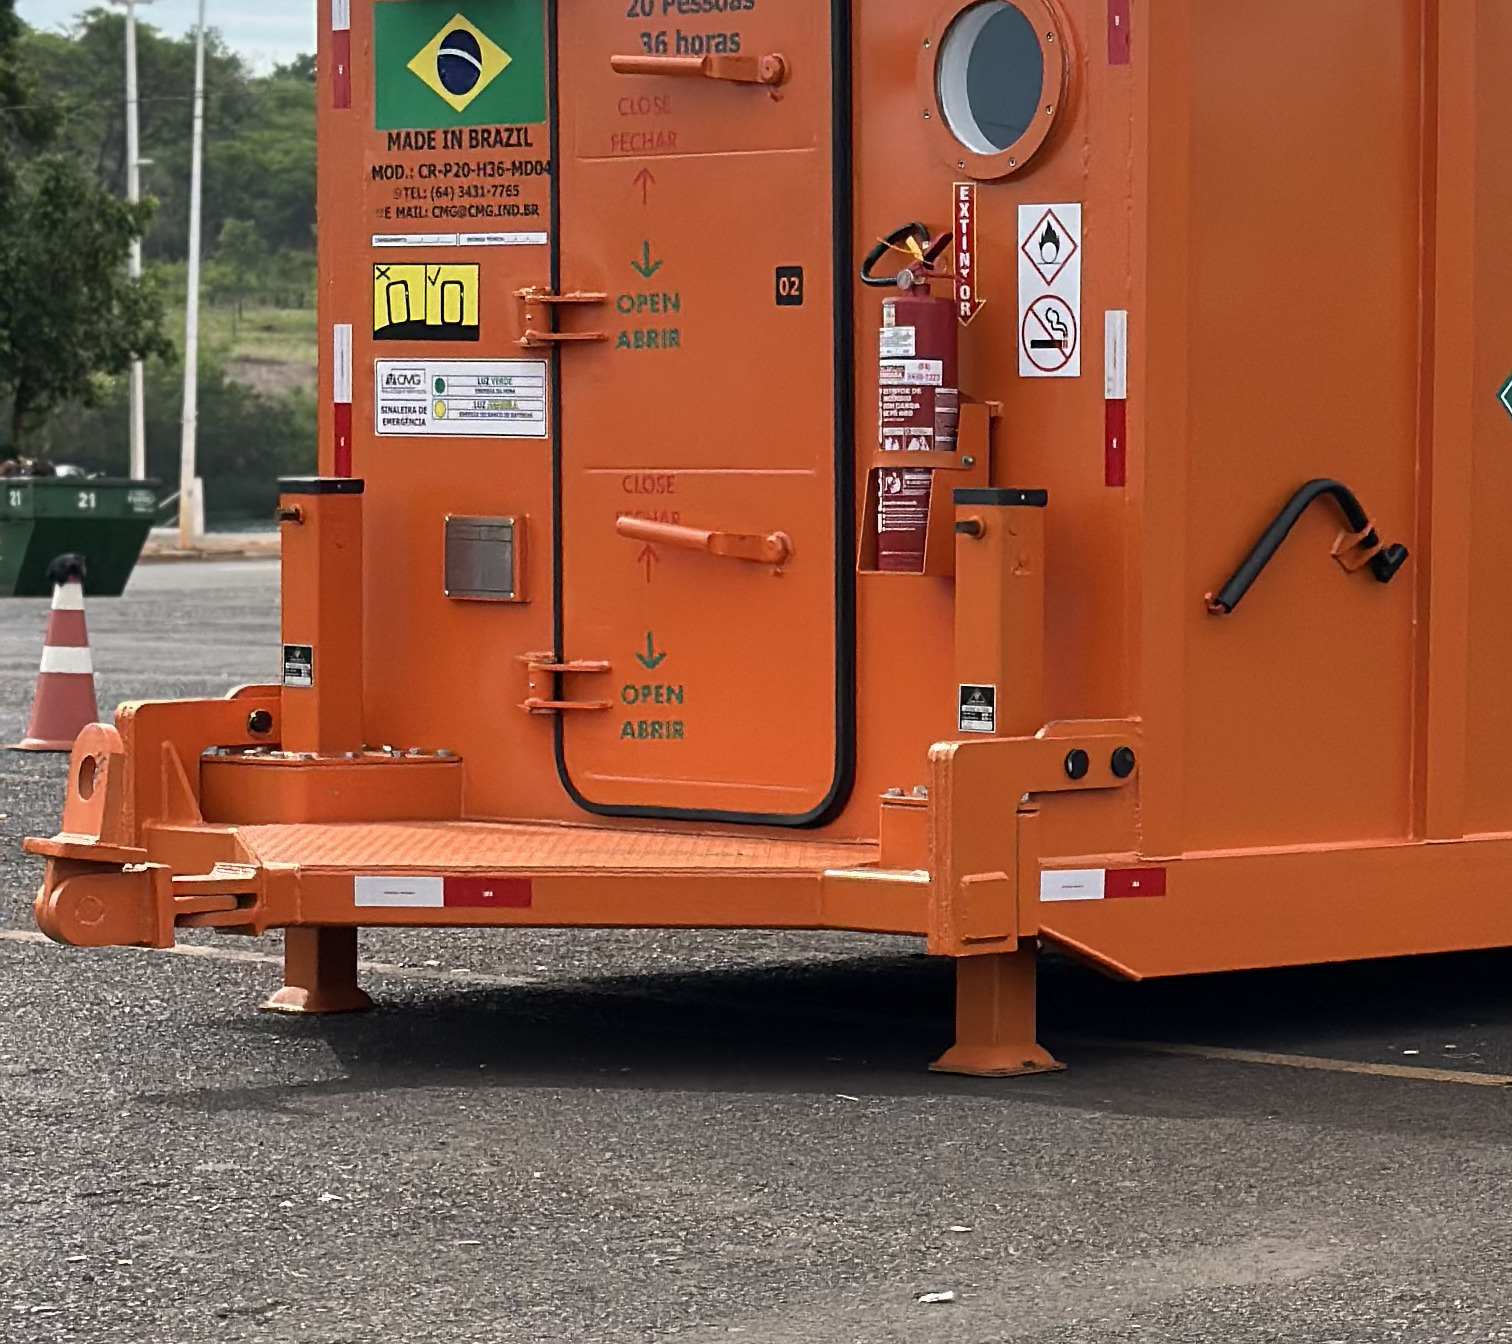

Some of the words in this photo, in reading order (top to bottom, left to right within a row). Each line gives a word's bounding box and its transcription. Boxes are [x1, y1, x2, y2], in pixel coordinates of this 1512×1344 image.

[640, 30, 668, 54] 36
[675, 29, 741, 55] horas
[618, 95, 672, 116] CLOSE
[387, 130, 437, 151] MADE
[442, 129, 464, 150] IN
[468, 127, 533, 149] BRAZIL
[611, 130, 677, 152] FECHAR
[371, 164, 414, 180] MOD.:
[418, 160, 551, 179] CR-P20-H36-MD04
[404, 186, 427, 200] TEL:
[430, 186, 455, 202] (64)
[395, 206, 428, 218] MAIL:
[431, 203, 540, 219] CMG@CMG.IND.BR
[779, 277, 800, 296] 02
[616, 292, 681, 314] OPEN
[615, 328, 681, 349] ABRIR
[380, 405, 417, 415] SINALEIRA
[622, 474, 676, 494] CLOSE
[78, 491, 97, 509] 21
[621, 684, 684, 705] OPEN
[620, 720, 684, 740] ABRIR
